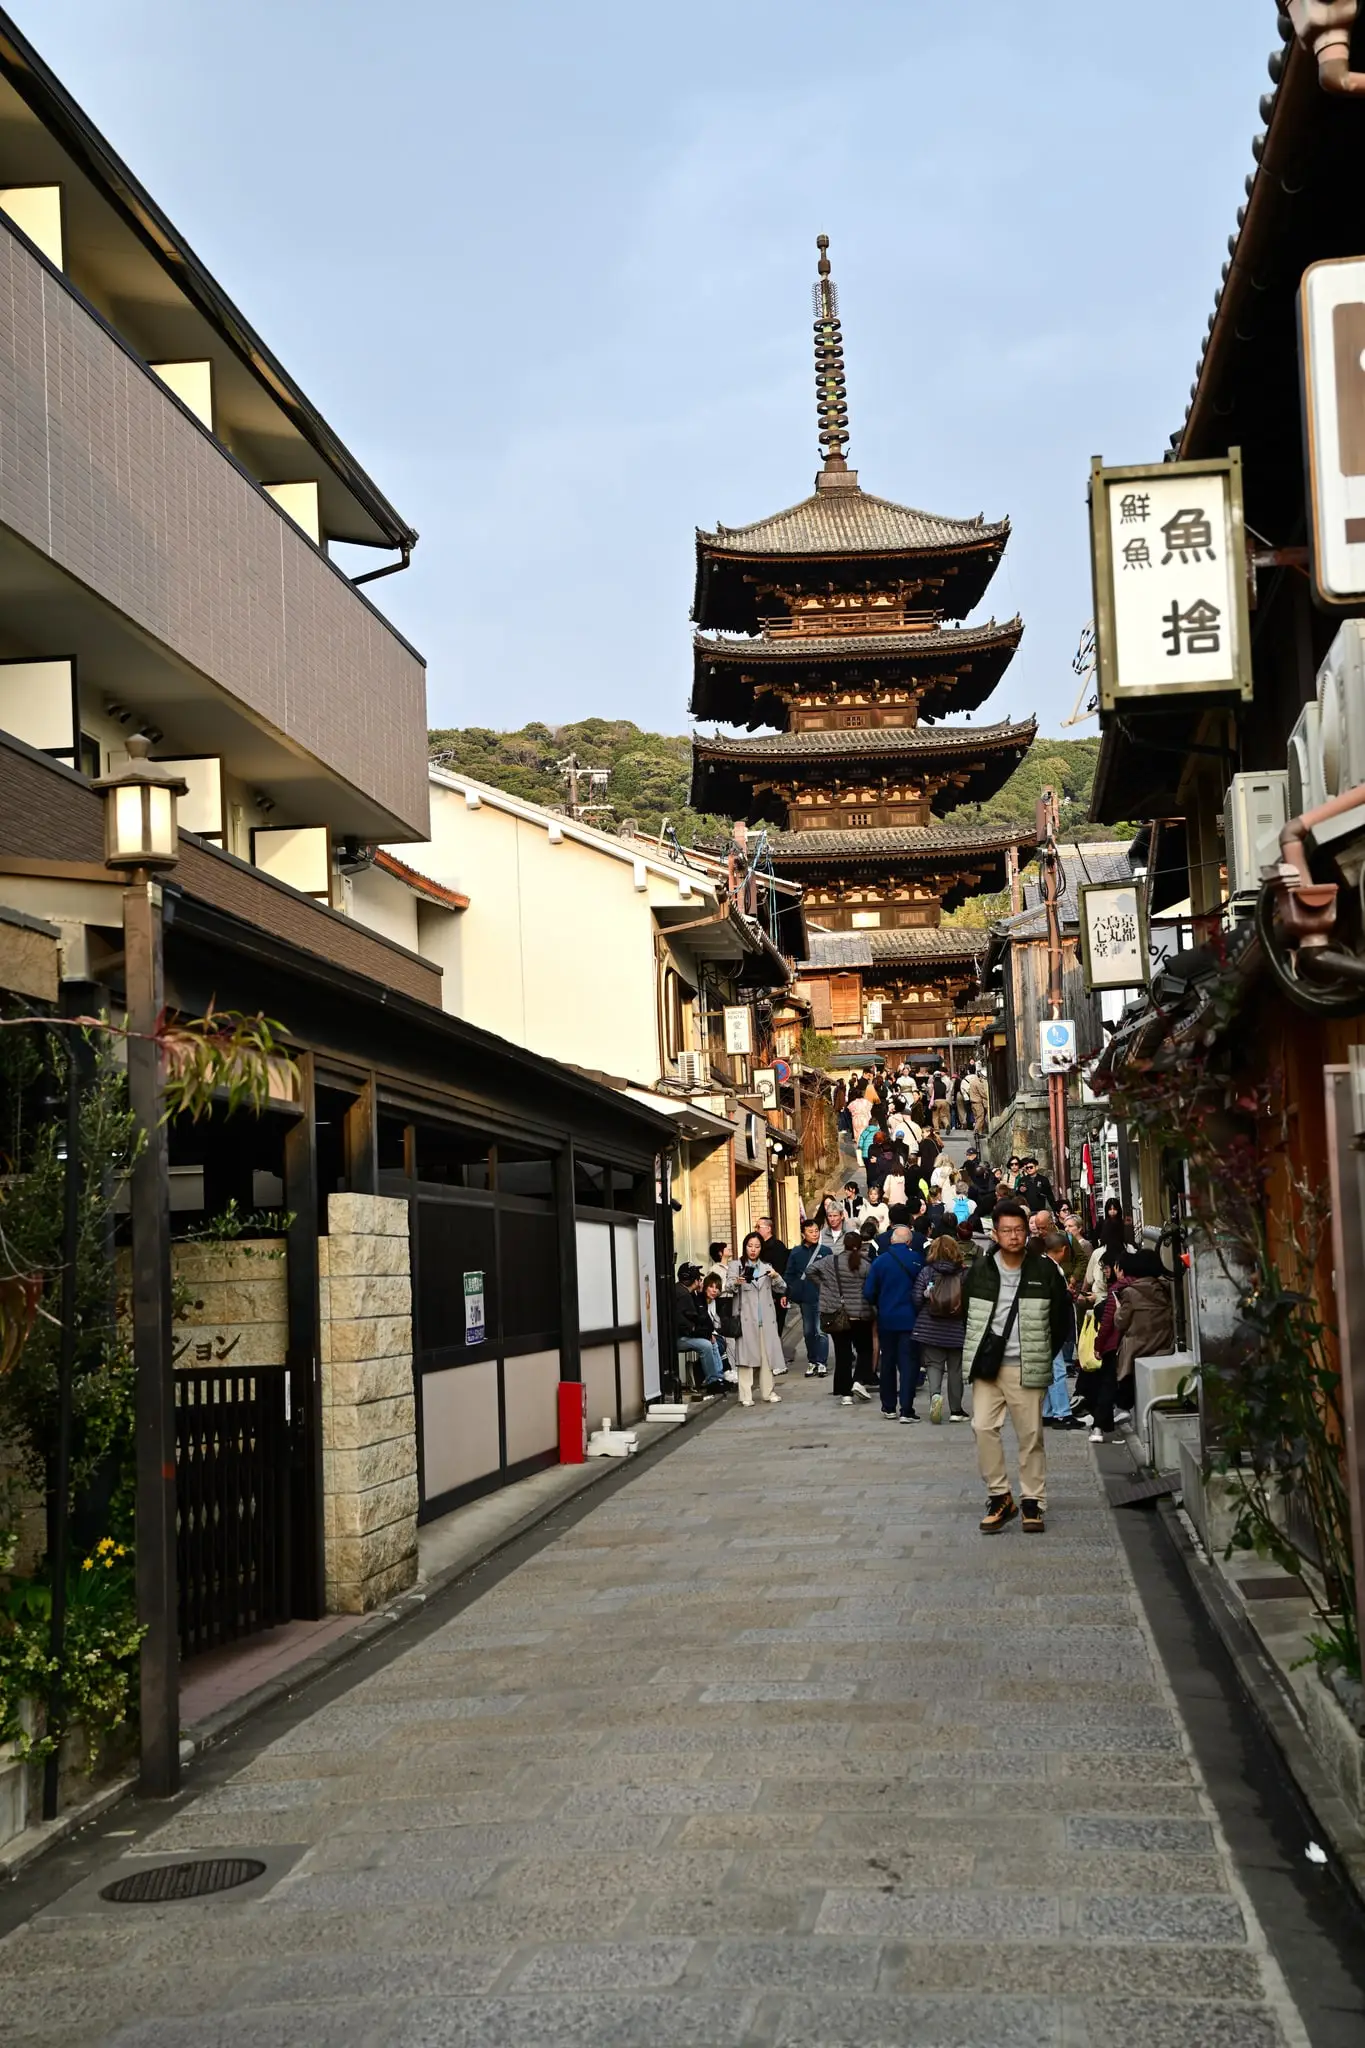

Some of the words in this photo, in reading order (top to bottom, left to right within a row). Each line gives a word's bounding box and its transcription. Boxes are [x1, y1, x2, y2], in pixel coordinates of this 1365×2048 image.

[1119, 493, 1152, 570] 鮮魚
[1160, 508, 1221, 656] 魚捨
[1121, 913, 1136, 942] 京都
